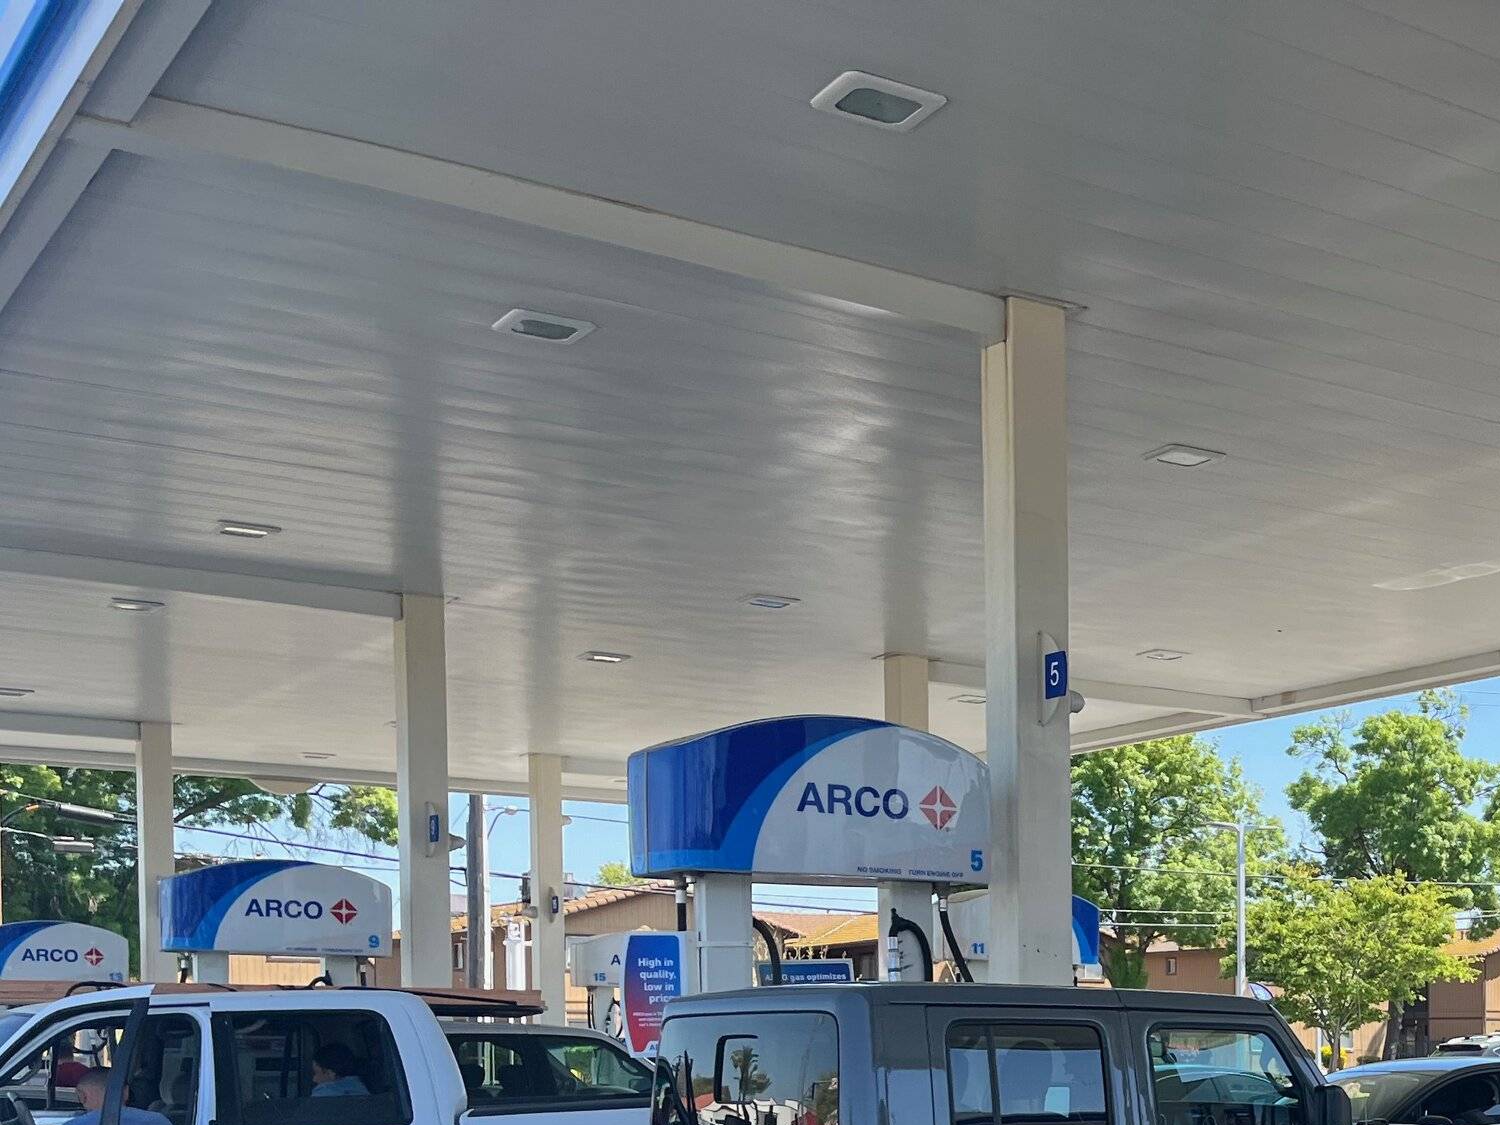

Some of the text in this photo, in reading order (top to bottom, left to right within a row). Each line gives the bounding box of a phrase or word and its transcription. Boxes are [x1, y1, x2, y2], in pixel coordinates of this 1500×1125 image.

[1050, 661, 1060, 686] 5
[796, 782, 909, 820] ARCO
[970, 849, 984, 872] 5
[245, 898, 323, 920] ARCO
[368, 934, 380, 949] 9
[971, 943, 985, 954] 11
[21, 948, 79, 963] ARCO
[638, 958, 674, 968] High in
[593, 972, 606, 982] 15
[789, 975, 805, 983] gas
[806, 973, 847, 982] optimizes
[664, 983, 674, 991] in
